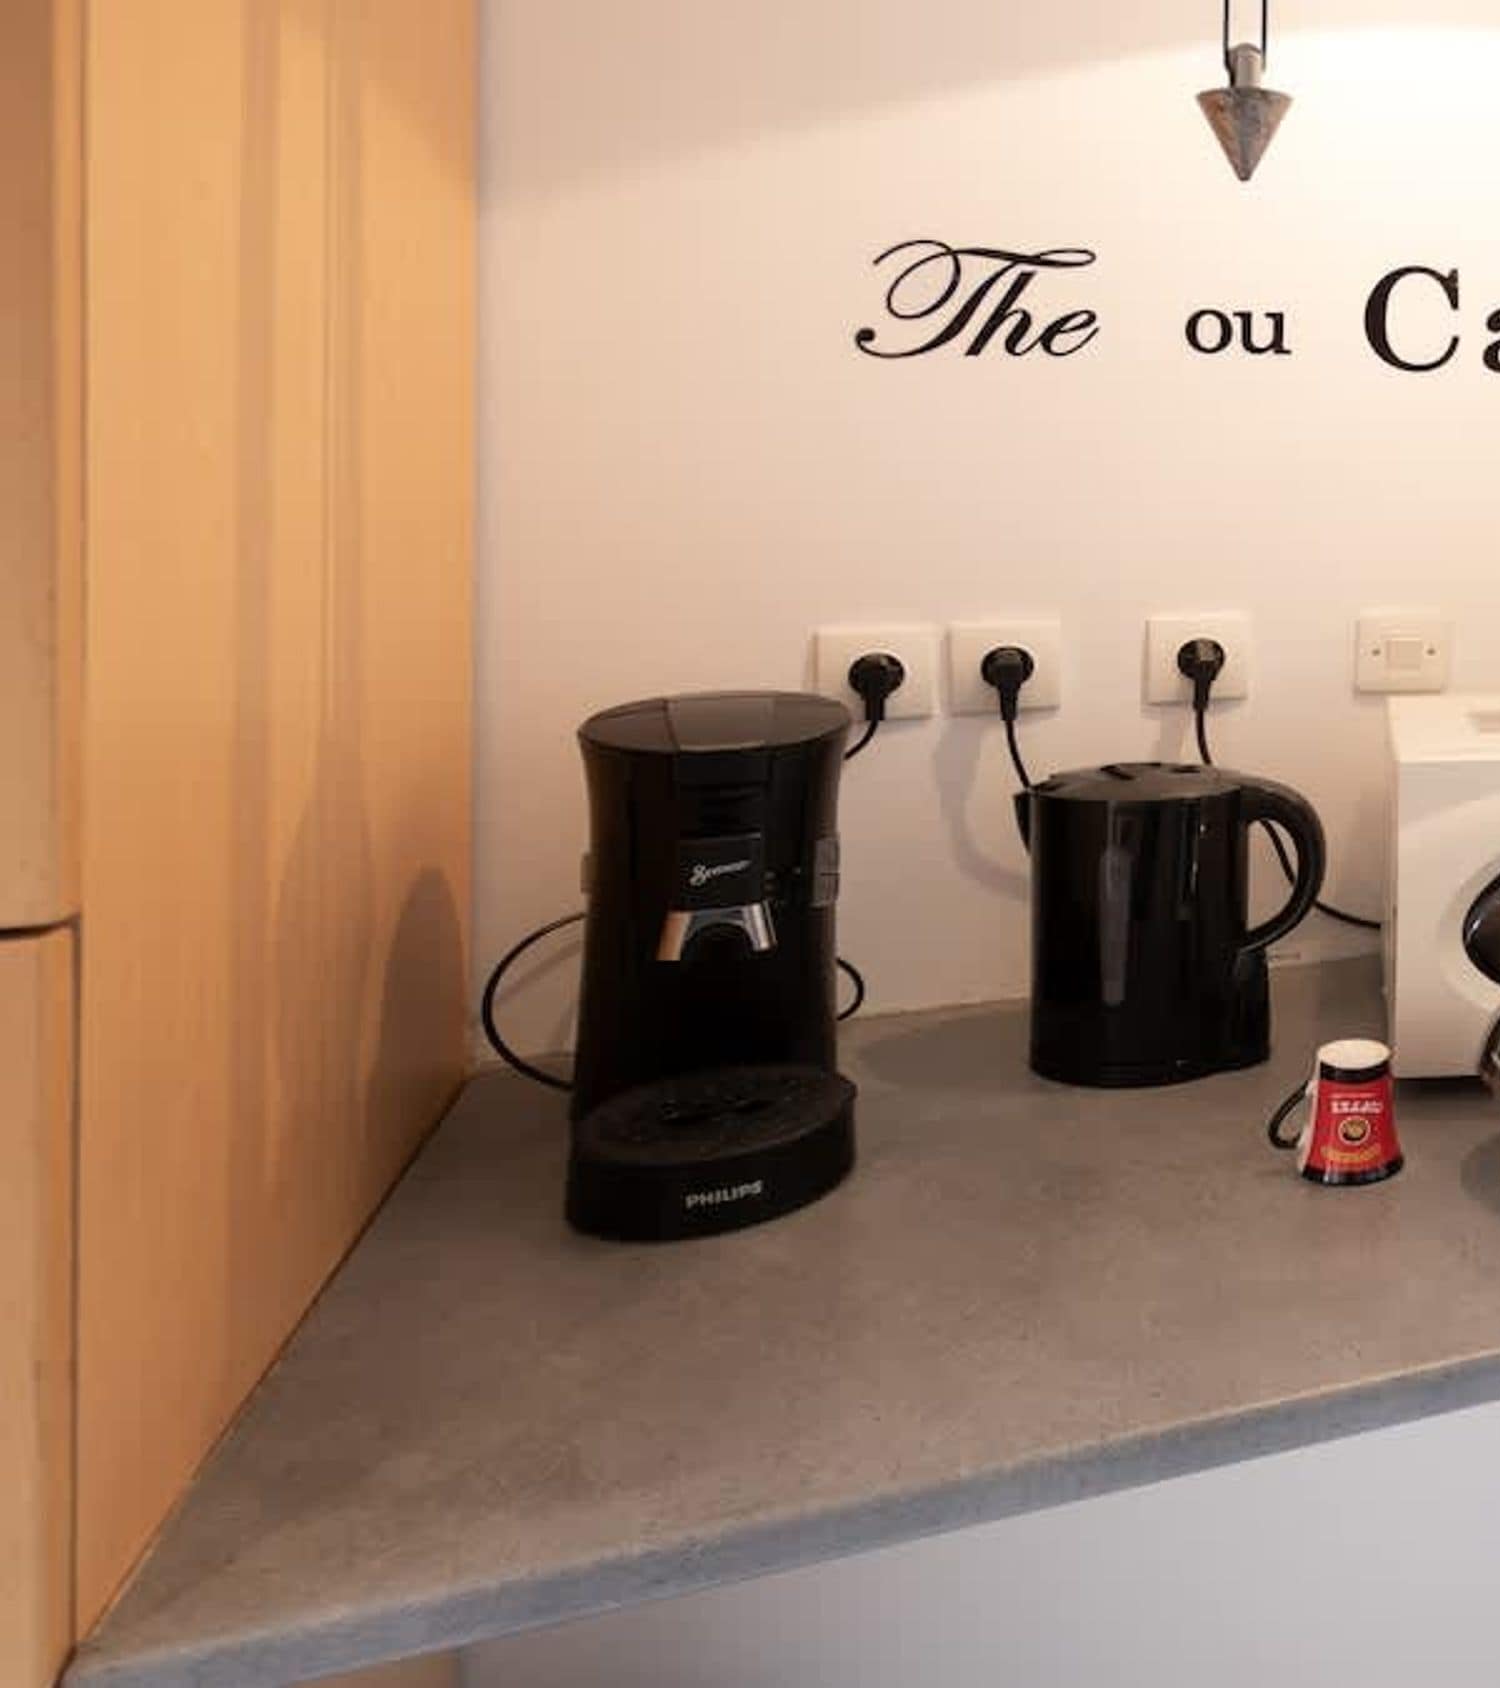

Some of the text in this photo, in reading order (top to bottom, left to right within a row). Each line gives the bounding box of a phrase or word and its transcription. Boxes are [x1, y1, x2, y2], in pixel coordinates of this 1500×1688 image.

[855, 240, 1099, 359] The
[1185, 306, 1292, 355] ou
[685, 1180, 762, 1208] PHILIPS
